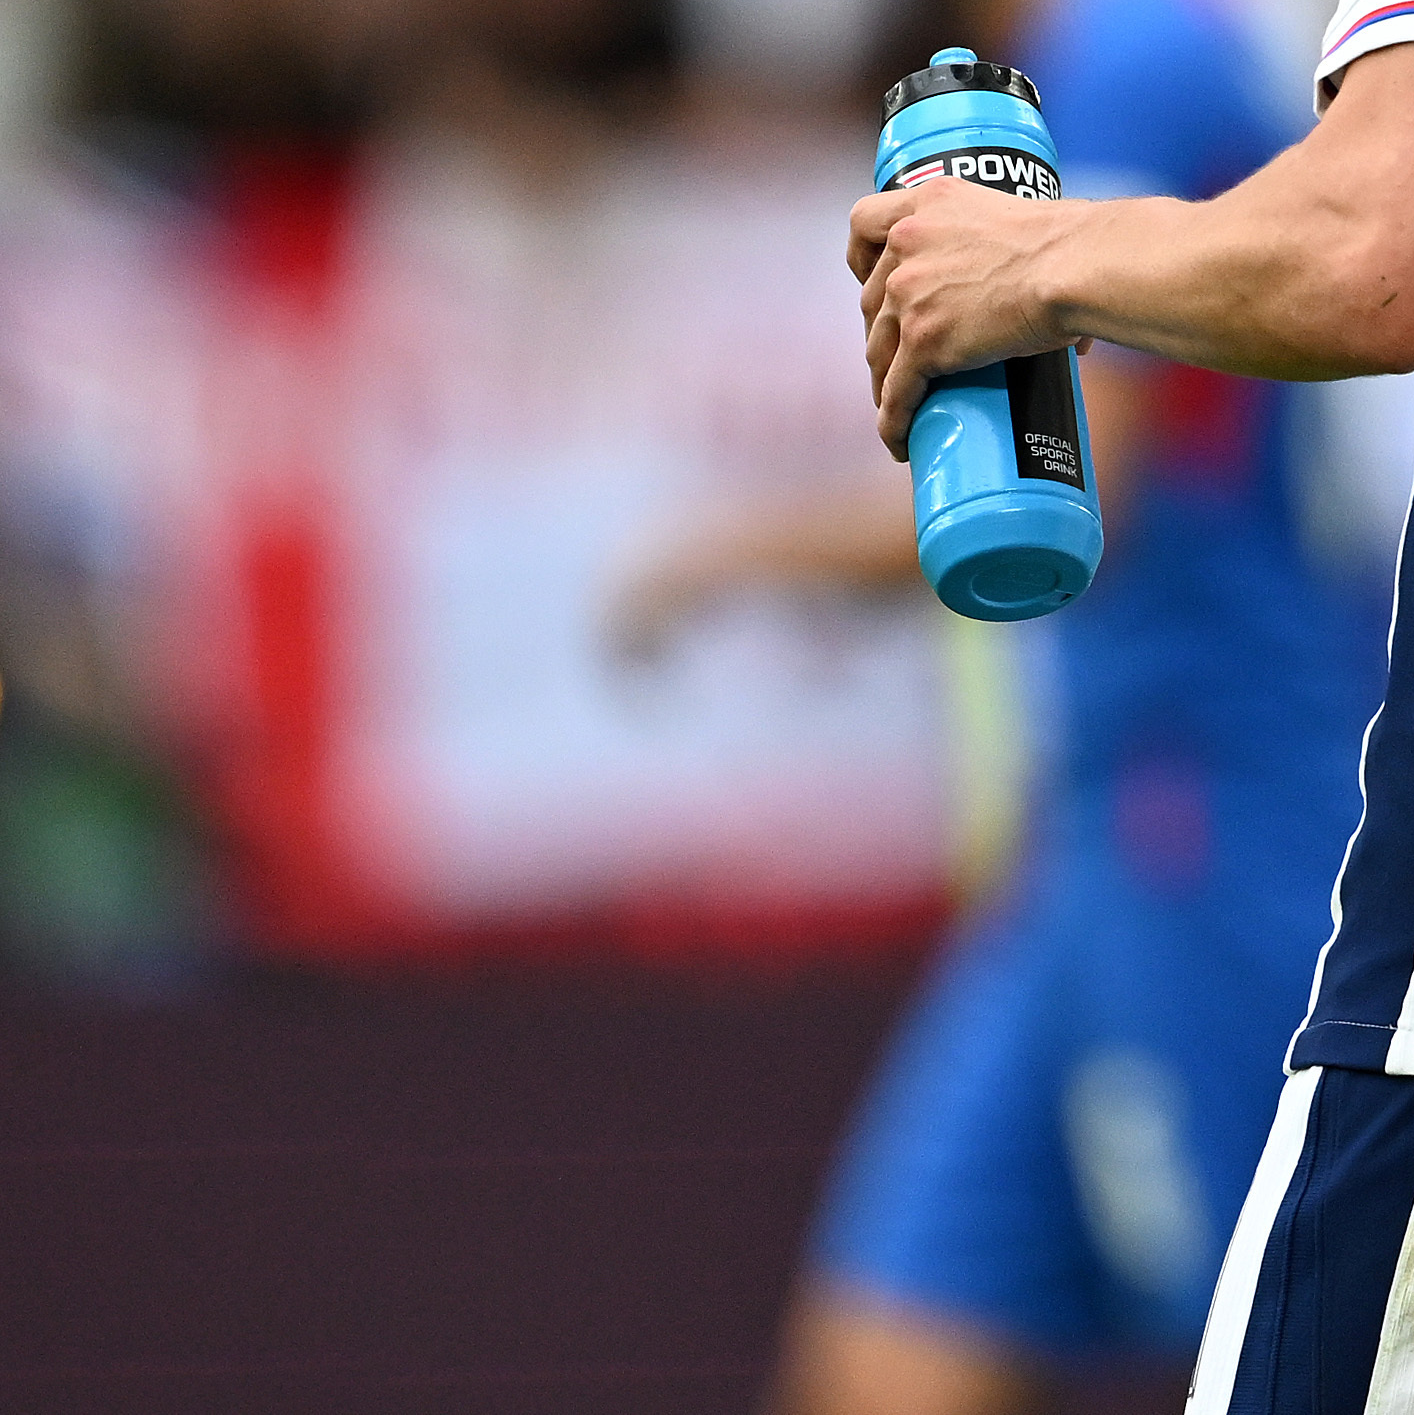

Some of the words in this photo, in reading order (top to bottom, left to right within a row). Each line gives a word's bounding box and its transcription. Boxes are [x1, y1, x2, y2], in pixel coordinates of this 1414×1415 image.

[950, 153, 1060, 201] POWER
[1024, 433, 1076, 454] OFFICIAL
[1030, 446, 1077, 466] SPORTS
[1043, 459, 1078, 479] DRINK
